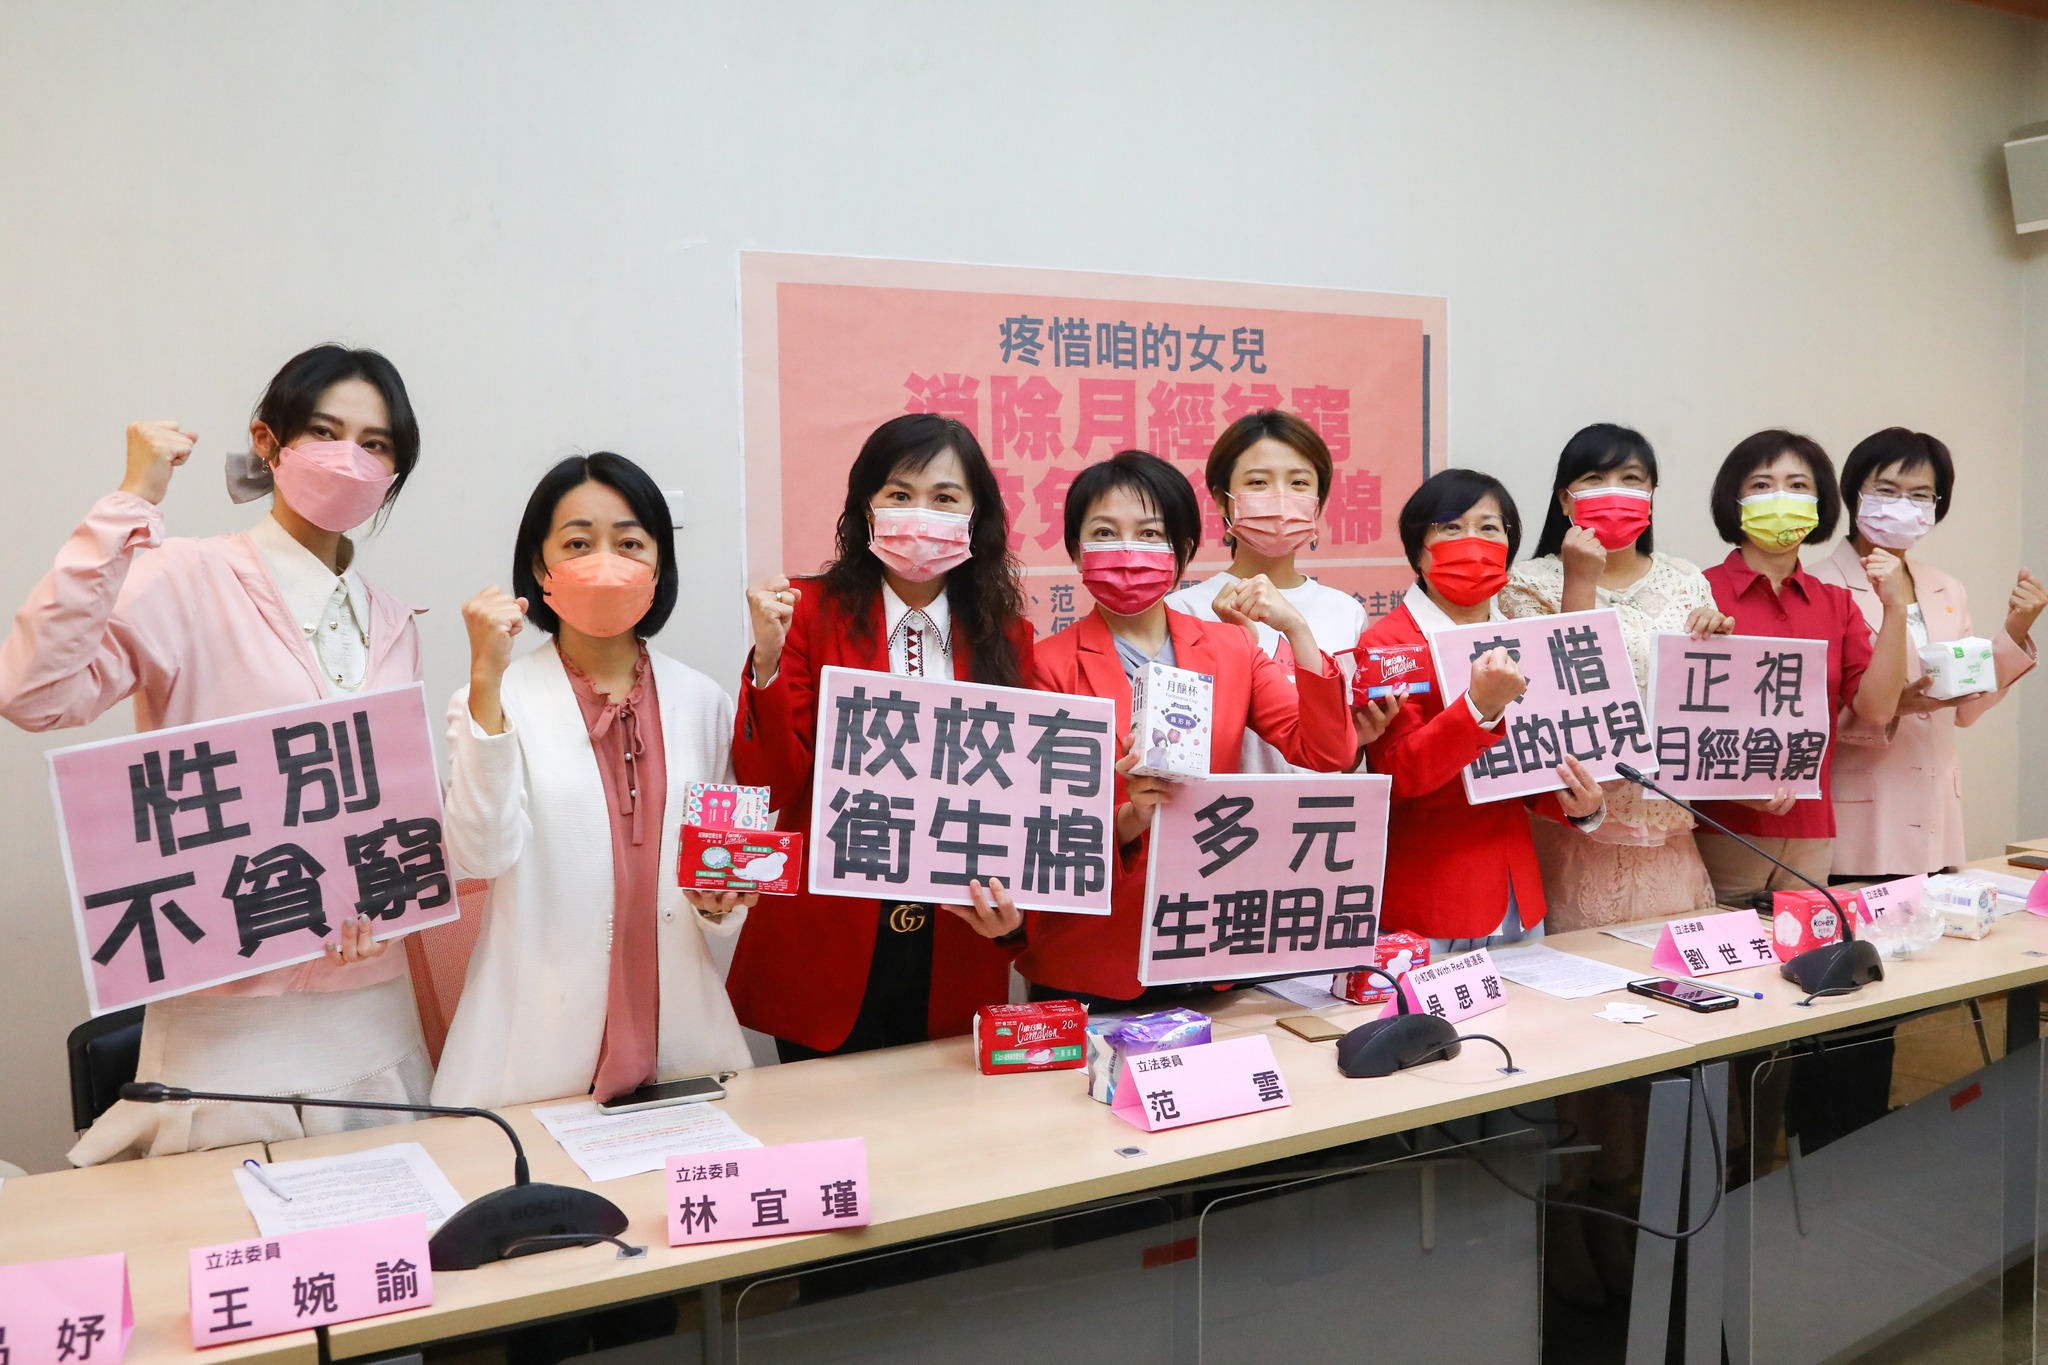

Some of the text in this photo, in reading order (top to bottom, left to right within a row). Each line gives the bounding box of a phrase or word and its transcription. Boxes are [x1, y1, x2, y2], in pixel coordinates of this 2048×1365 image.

[998, 314, 1268, 375] 疼惜咱的女兒
[1678, 650, 1804, 718] 正視
[830, 685, 1109, 798] 校校有
[1653, 725, 1826, 783] 月經貧窮
[127, 710, 382, 858] 性別
[826, 786, 1106, 897] 衛生棉
[1192, 793, 1357, 879] 多元
[83, 816, 453, 985] 不貧窮
[1866, 887, 1889, 900] 立法委員
[1151, 884, 1377, 961] 生理用品
[1674, 922, 1705, 935] 立法委員
[1435, 964, 1452, 978] With
[1450, 961, 1465, 973] Red
[1463, 953, 1485, 969] 營運長
[1683, 938, 1772, 971] 劉世芳
[1017, 1022, 1062, 1045] Carnation
[1137, 1055, 1184, 1073] 立法委員
[1147, 1070, 1284, 1122] 范雲
[676, 1162, 739, 1183] 立法委員
[680, 1179, 859, 1235] 林宜瑾
[205, 1242, 282, 1270] 立法委員
[209, 1258, 419, 1333] 王婉諭
[0, 1314, 105, 1365] 妤
